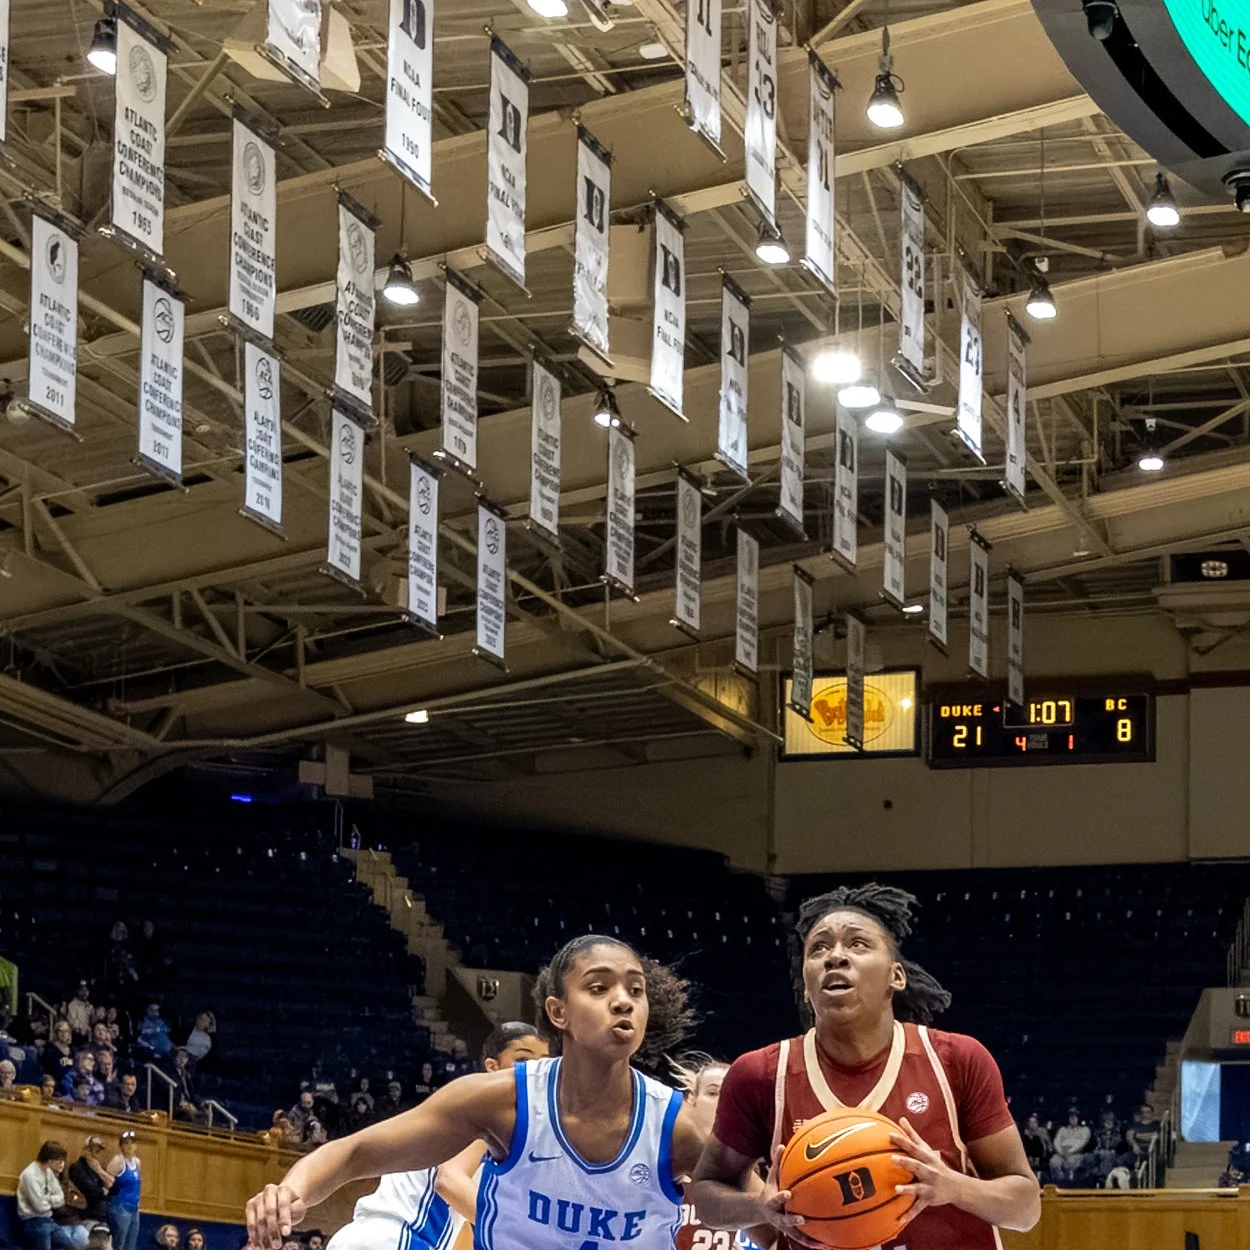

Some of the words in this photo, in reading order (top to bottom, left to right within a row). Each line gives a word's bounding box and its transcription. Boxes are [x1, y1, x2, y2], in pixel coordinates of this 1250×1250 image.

[1202, 0, 1234, 53] Uber
[391, 77, 410, 107] FINAL
[125, 107, 157, 142] ATLANTIC
[130, 129, 152, 154] COAST
[117, 140, 164, 185] CONFERENC
[119, 161, 162, 202] CHAMPIONS
[39, 293, 71, 322] ATLANTIC
[46, 386, 65, 407] 2011
[940, 703, 983, 718] DUKE
[1030, 700, 1071, 724] 1:07
[953, 725, 982, 748] 21
[1015, 736, 1027, 752] 4
[1117, 719, 1132, 742] 8
[528, 1189, 647, 1241] DUKE
